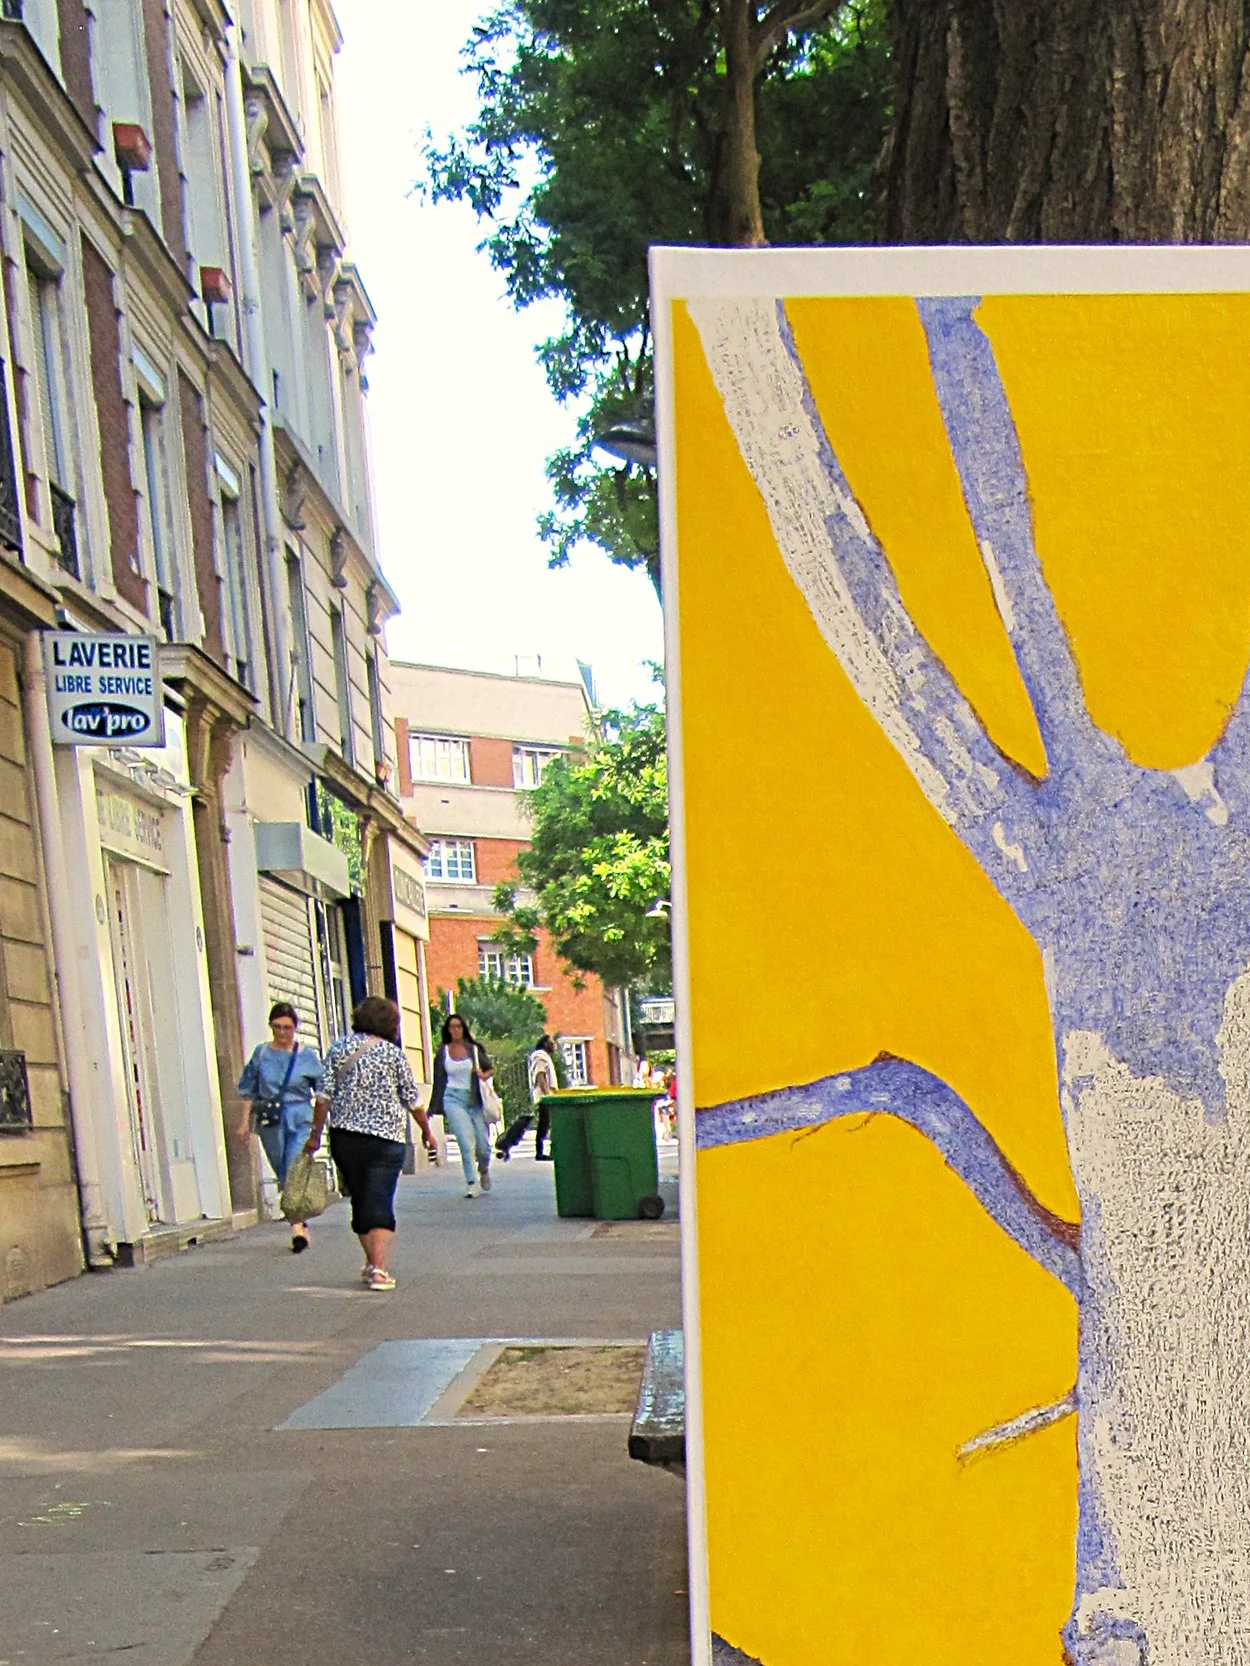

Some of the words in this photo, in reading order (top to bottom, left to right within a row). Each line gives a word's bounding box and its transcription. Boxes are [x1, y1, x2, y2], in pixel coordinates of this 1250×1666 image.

[53, 641, 151, 669] LAVERIE
[55, 675, 92, 693] LIBRE
[99, 676, 153, 695] SERVICE
[67, 706, 145, 736] lav'pro
